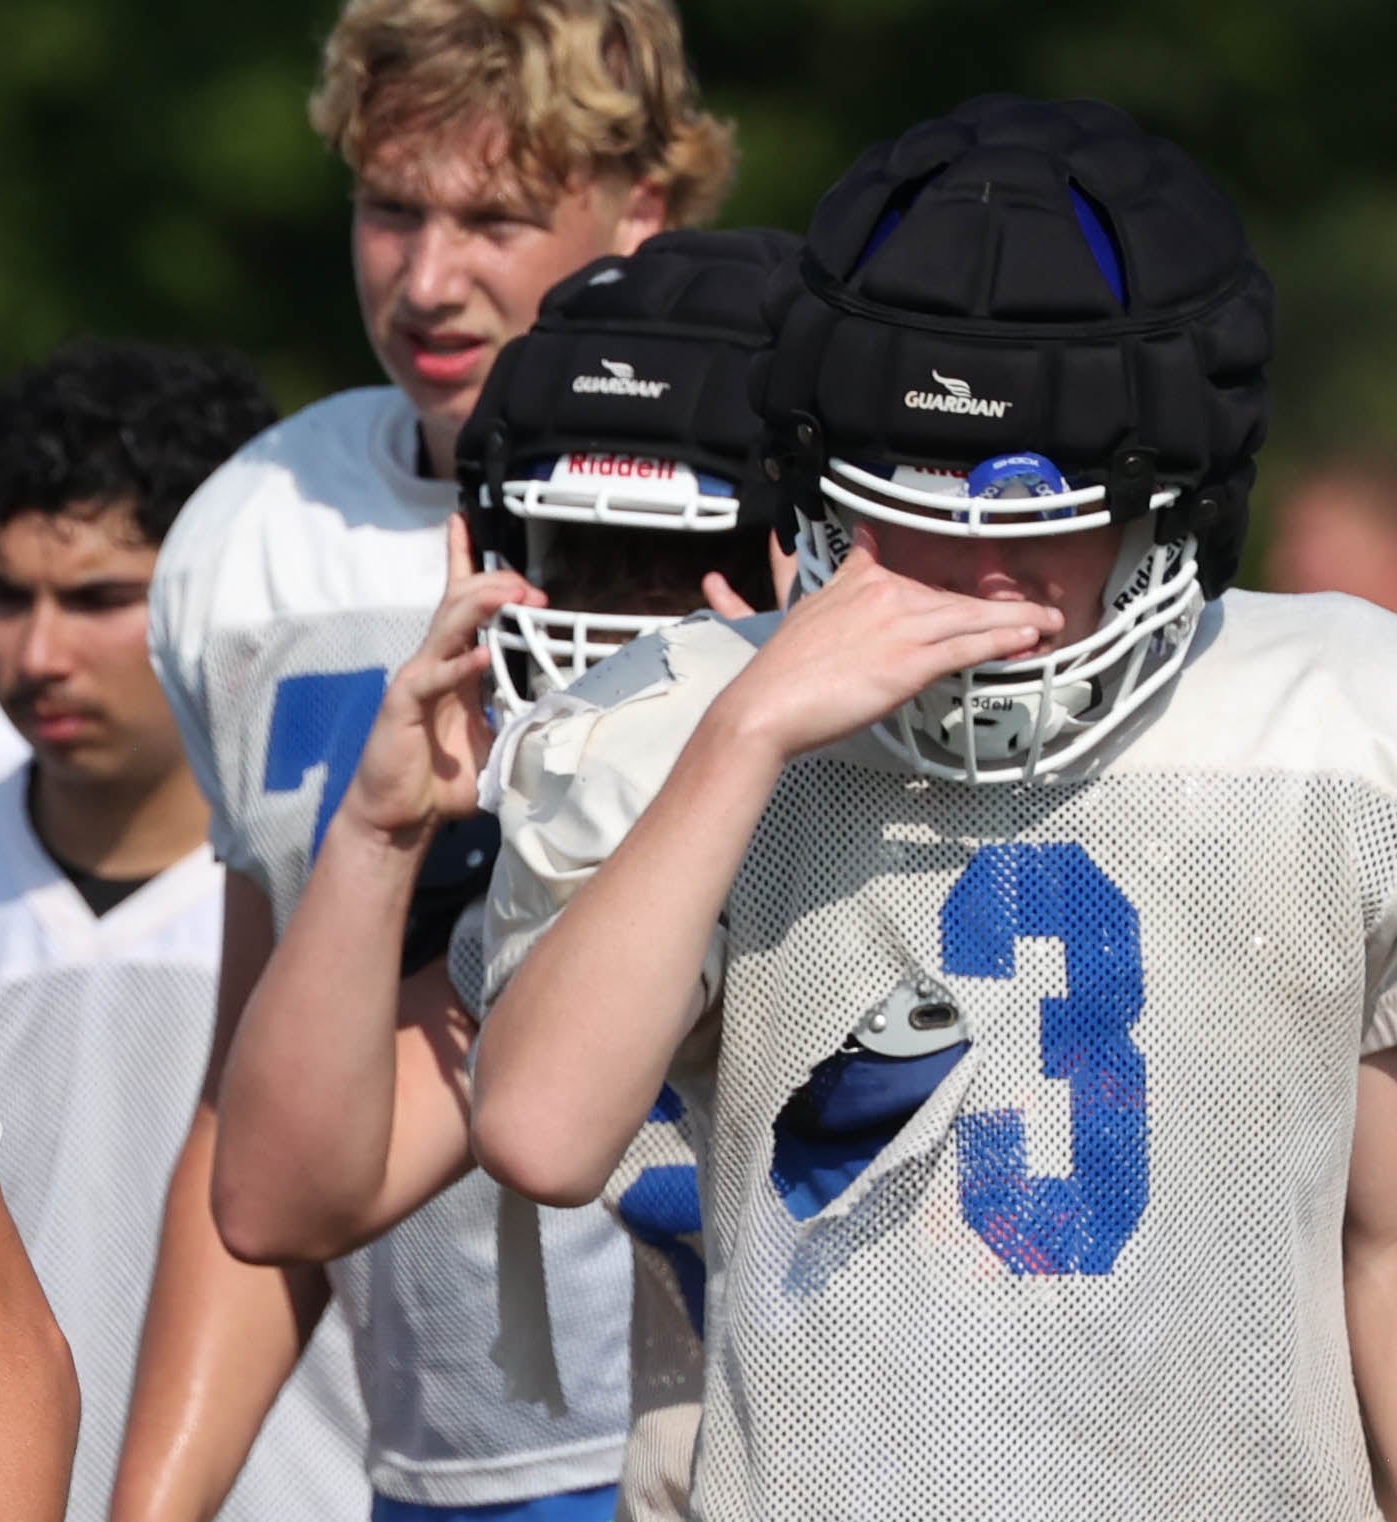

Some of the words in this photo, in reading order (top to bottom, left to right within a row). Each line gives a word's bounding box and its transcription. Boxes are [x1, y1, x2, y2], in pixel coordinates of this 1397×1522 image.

[572, 375, 664, 398] GUARDIAN
[905, 391, 1006, 418] GUARDIAN
[568, 452, 678, 480] Riddell
